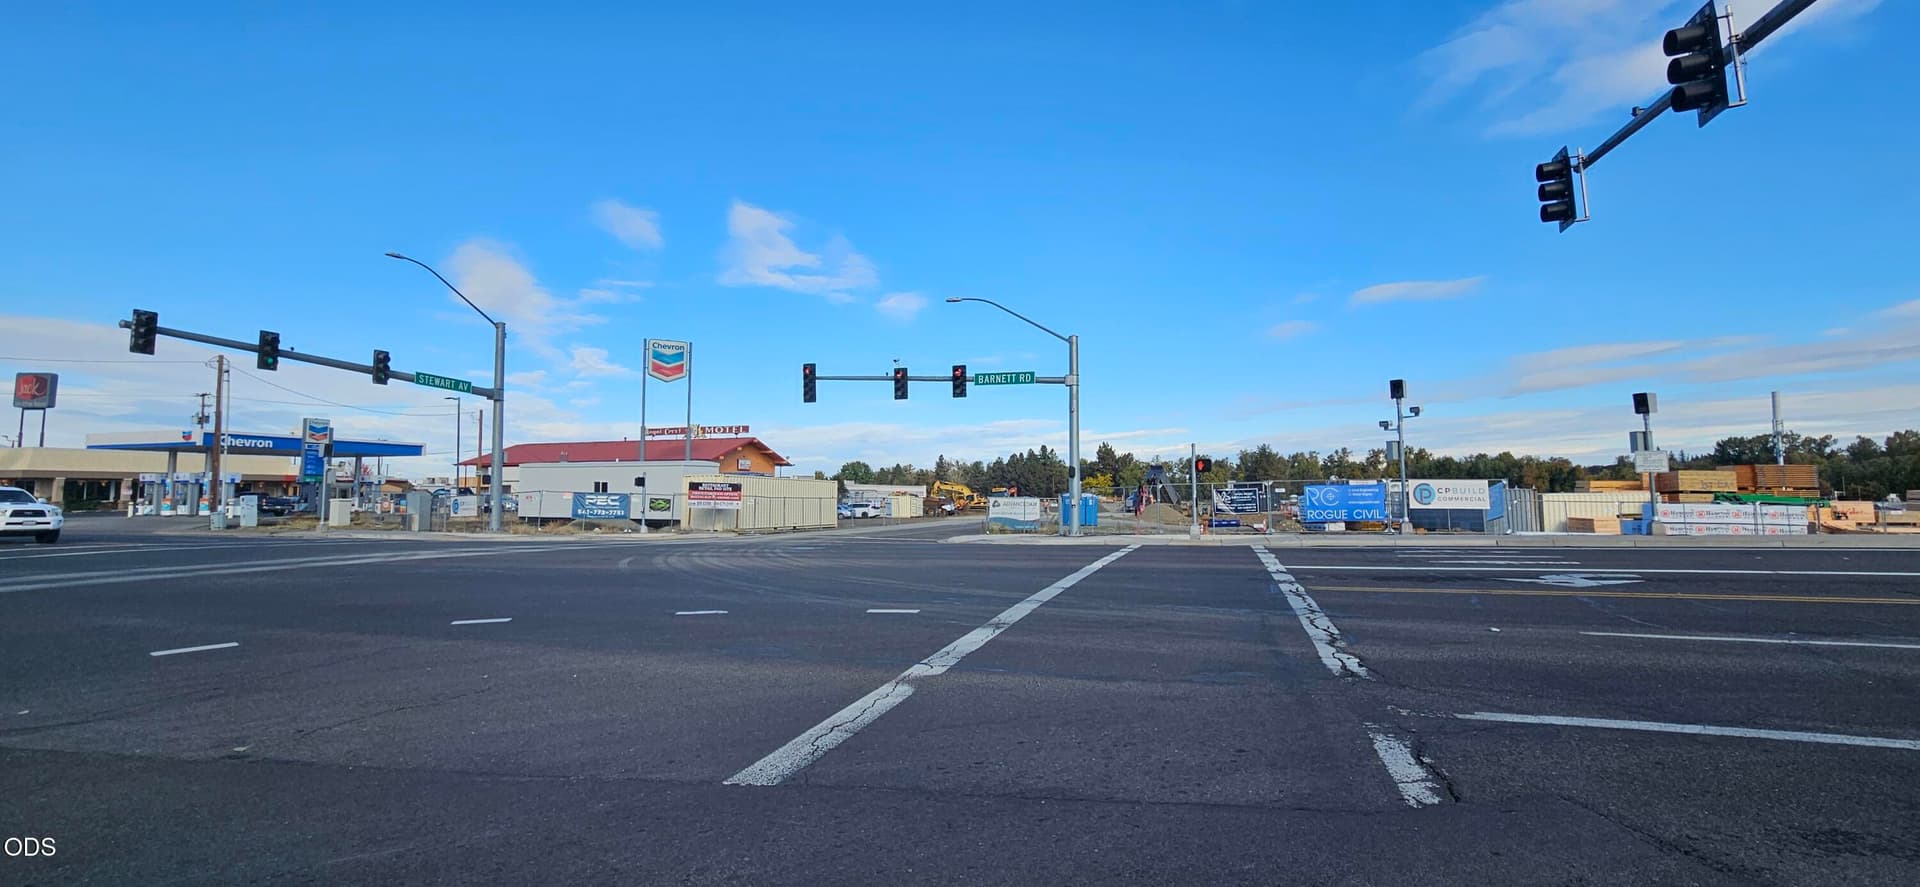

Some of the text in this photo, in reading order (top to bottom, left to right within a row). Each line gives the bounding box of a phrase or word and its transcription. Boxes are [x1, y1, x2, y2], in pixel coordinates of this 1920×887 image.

[652, 341, 685, 351] Chevron
[418, 374, 469, 391] STEWART AV
[978, 373, 1031, 384] BARNETT RD
[705, 426, 743, 435] MOTEL
[220, 435, 273, 449] Chevron
[585, 494, 621, 506] PEC
[1307, 509, 1385, 520] ROGUE CIVIL
